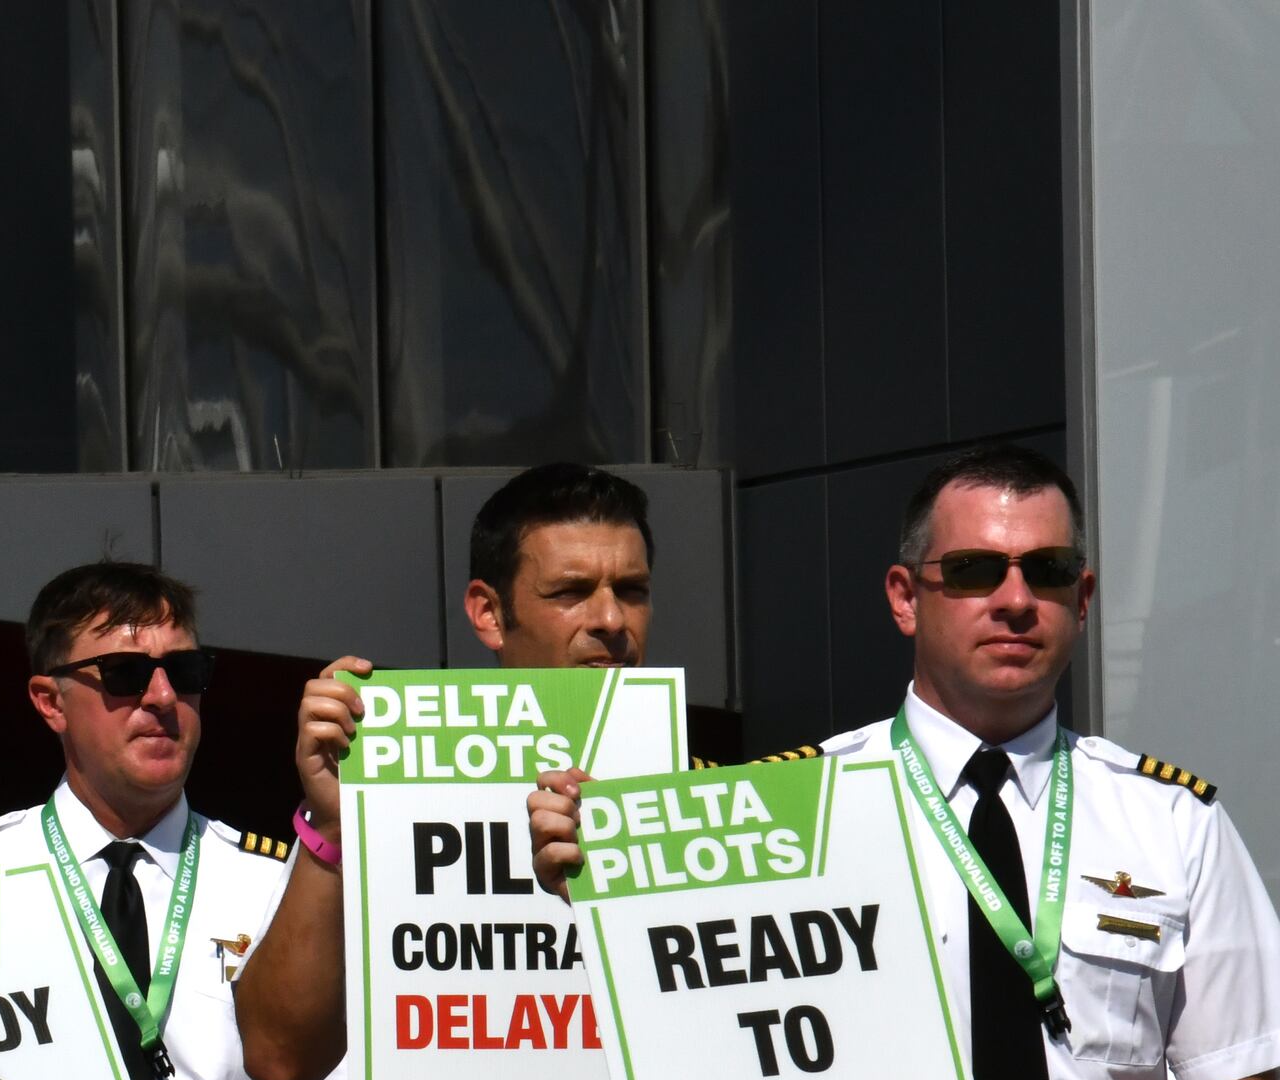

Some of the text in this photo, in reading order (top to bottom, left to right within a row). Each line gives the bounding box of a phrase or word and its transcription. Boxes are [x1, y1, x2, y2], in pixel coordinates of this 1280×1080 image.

[360, 684, 547, 728] DELTA
[363, 734, 573, 778] PILOTS
[578, 780, 772, 842] DELTA
[1055, 779, 1069, 810] NEW
[898, 738, 1003, 912] FATIGUED AND UNDERVALUED
[1053, 823, 1066, 841] TO
[1055, 810, 1067, 821] A
[413, 822, 533, 894] PIL
[587, 828, 806, 893] PILOTS
[1050, 841, 1065, 868] OFF
[46, 815, 118, 966] FATIGUED AND UNDERVALUED
[178, 865, 193, 894] NEW
[1045, 868, 1061, 902] HATS
[173, 904, 184, 920] TO
[178, 893, 187, 904] A
[167, 919, 182, 945] OFF
[648, 904, 879, 992] READY
[159, 943, 176, 976] HATS
[737, 1005, 834, 1076] TO
